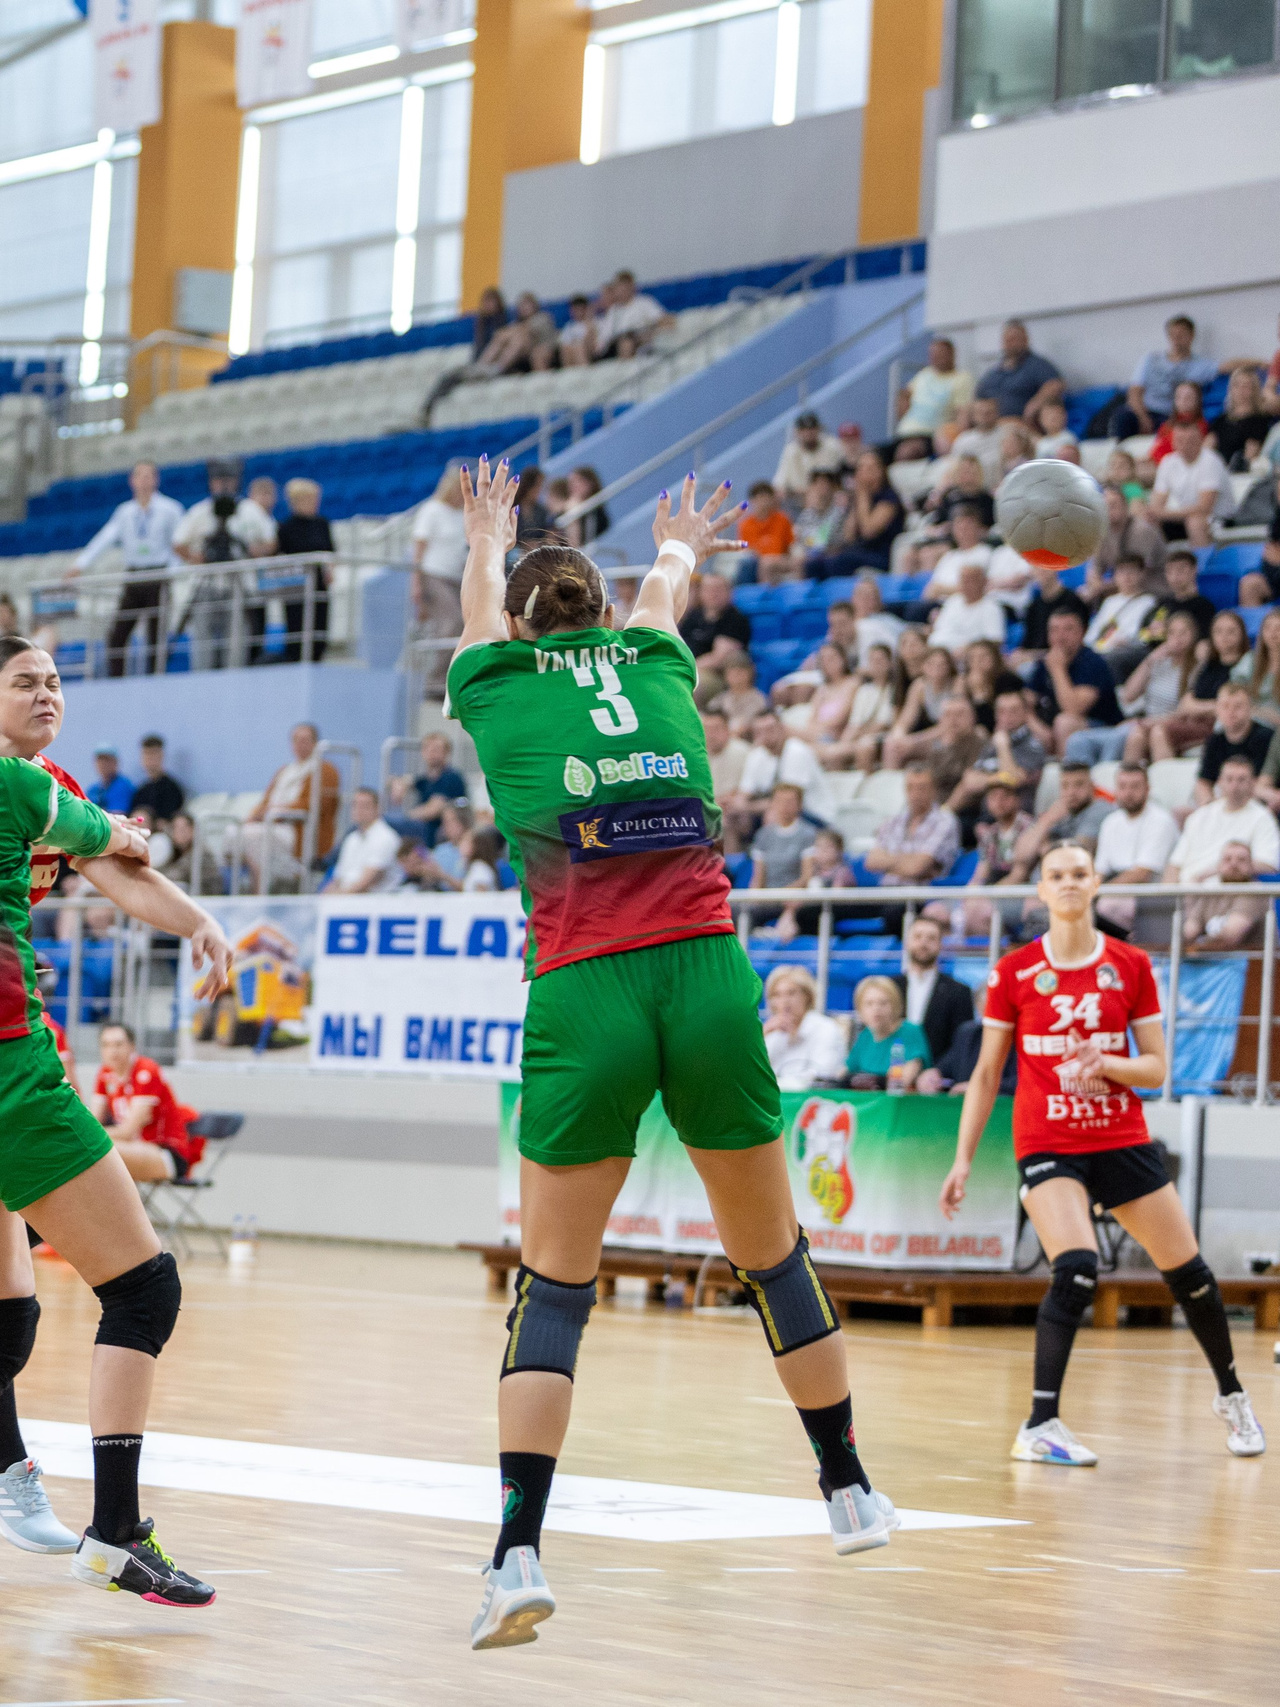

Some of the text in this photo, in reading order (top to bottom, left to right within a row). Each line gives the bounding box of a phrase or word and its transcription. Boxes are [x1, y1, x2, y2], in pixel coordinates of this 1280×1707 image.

[572, 665, 639, 736] 3
[597, 752, 688, 784] BelFert
[326, 917, 526, 958] BELA
[1048, 992, 1102, 1032] 34
[319, 1014, 382, 1057] МЫ
